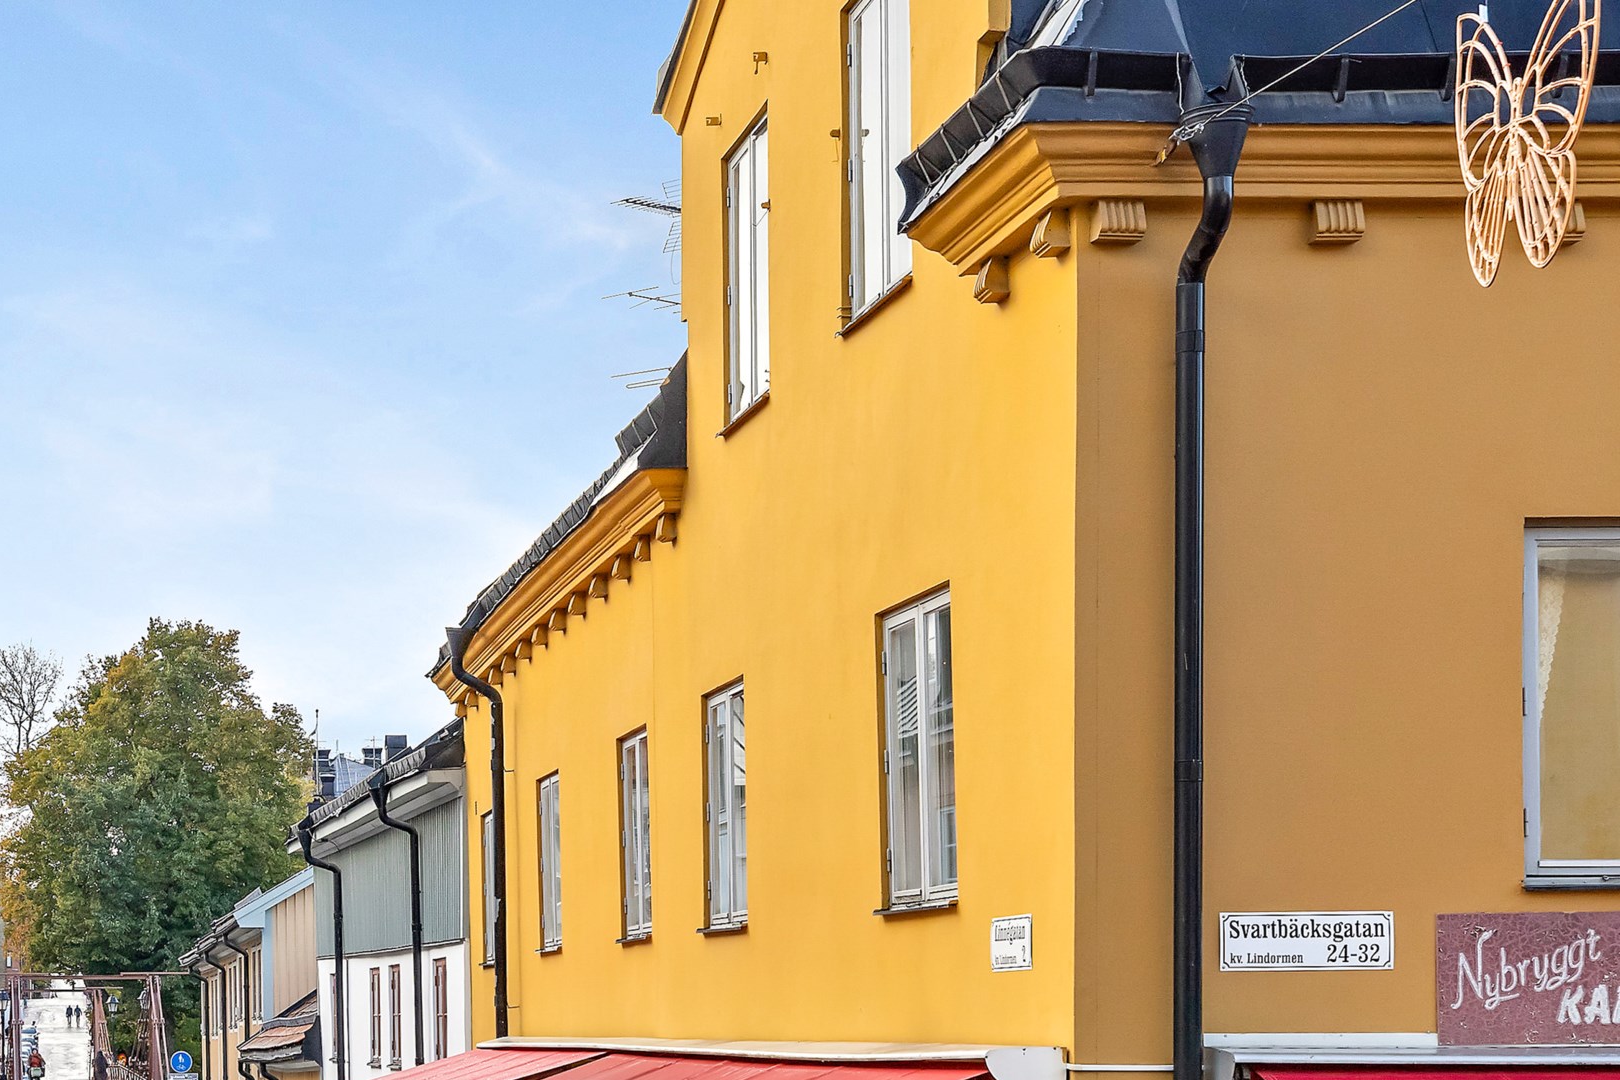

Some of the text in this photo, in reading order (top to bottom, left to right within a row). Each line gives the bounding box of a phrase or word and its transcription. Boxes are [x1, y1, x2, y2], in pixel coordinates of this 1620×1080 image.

[1229, 919, 1385, 942] Svartbäcksgatan
[1230, 952, 1304, 964] kv. Lindormen
[1327, 944, 1380, 963] 24-32
[1450, 928, 1602, 1010] Nybryggt
